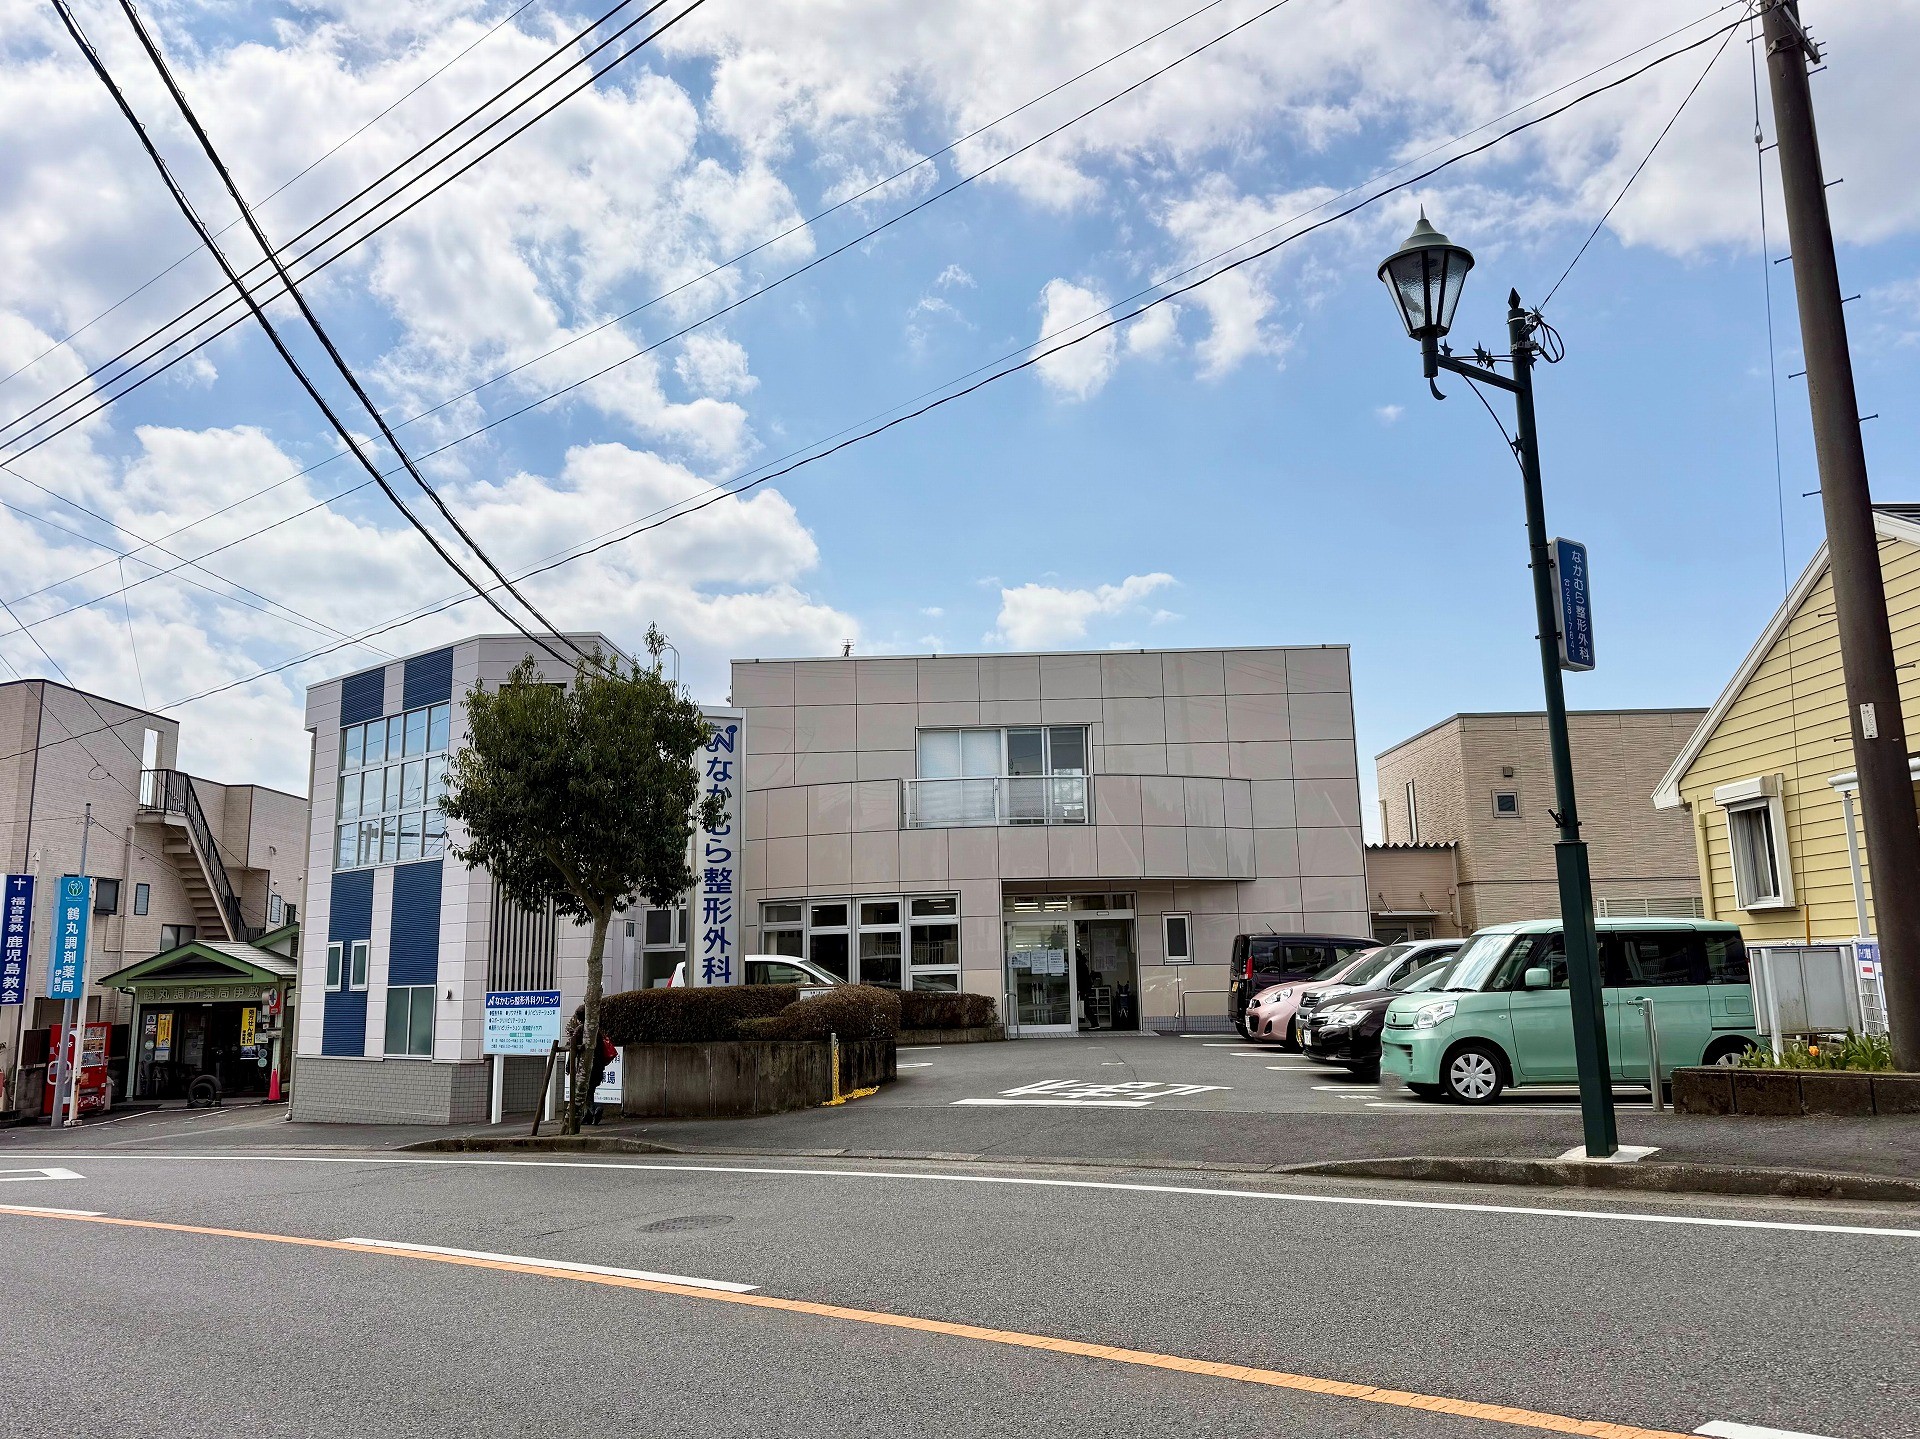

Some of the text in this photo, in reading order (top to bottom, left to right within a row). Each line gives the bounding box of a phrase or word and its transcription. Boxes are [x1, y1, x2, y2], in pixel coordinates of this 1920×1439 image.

[1571, 550, 1590, 661] なかむら整形外科
[1, 935, 24, 1003] 鹿児島教会
[60, 906, 80, 993] 鶴丸調剤薬局
[143, 985, 270, 1001] 鶴丸調剤薬局伊敷
[495, 995, 559, 1006] なかむら整形外科クリニック
